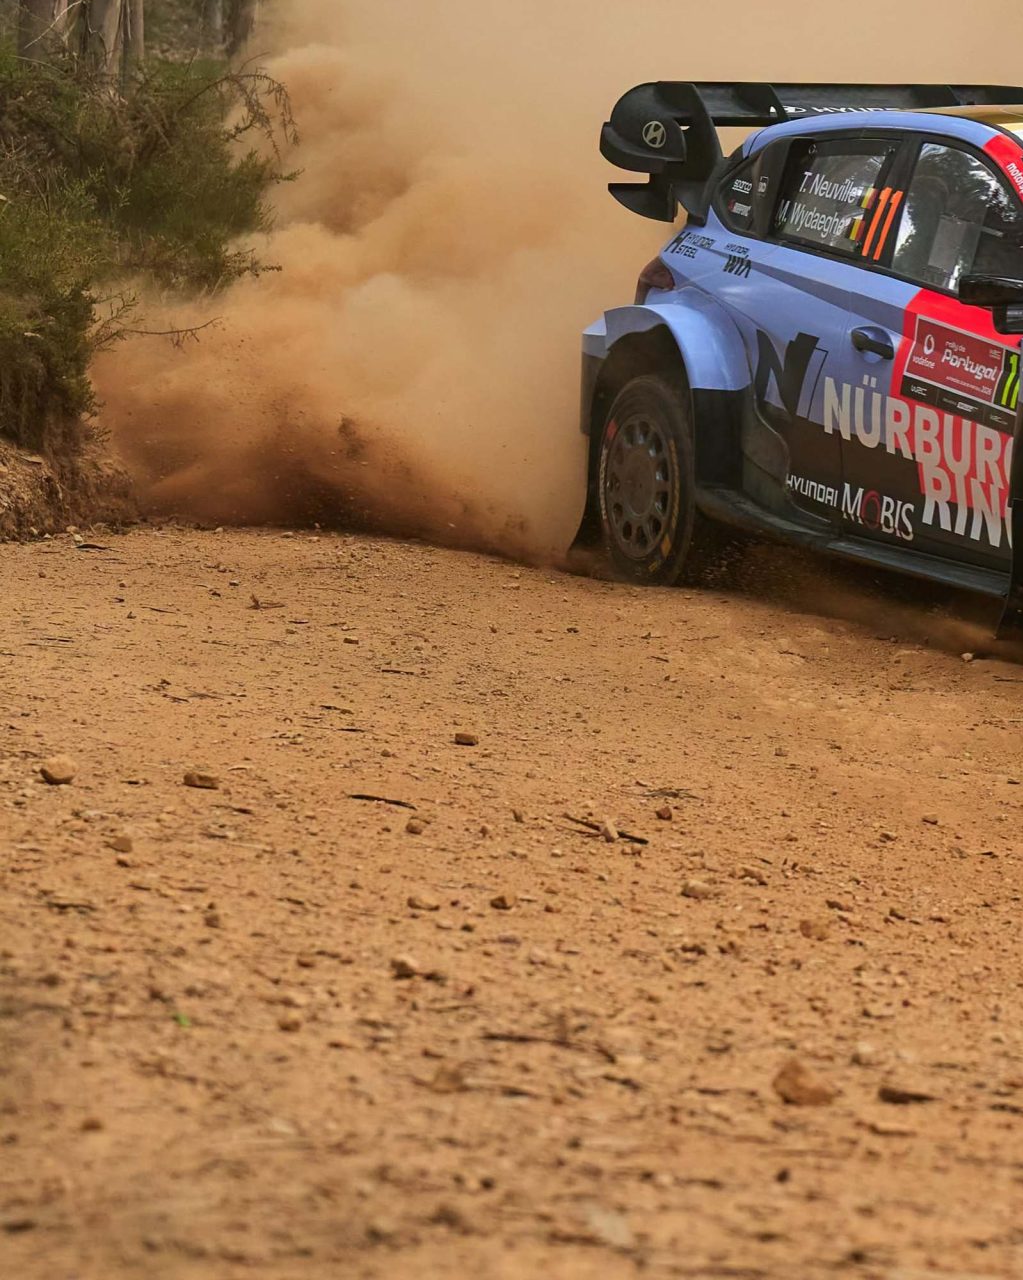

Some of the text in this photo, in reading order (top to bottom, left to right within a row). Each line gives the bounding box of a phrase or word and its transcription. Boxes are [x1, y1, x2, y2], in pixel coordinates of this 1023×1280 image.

[799, 171, 813, 193] T.
[808, 173, 857, 203] Neuville
[790, 202, 845, 238] Wydaeghe
[862, 186, 904, 261] 11
[676, 244, 699, 259] STEEL
[941, 348, 998, 381] Portugal
[823, 374, 1014, 489] NÜRBUR
[785, 473, 915, 542] HYUNDAI MOBIS
[922, 461, 1013, 549] RIN
